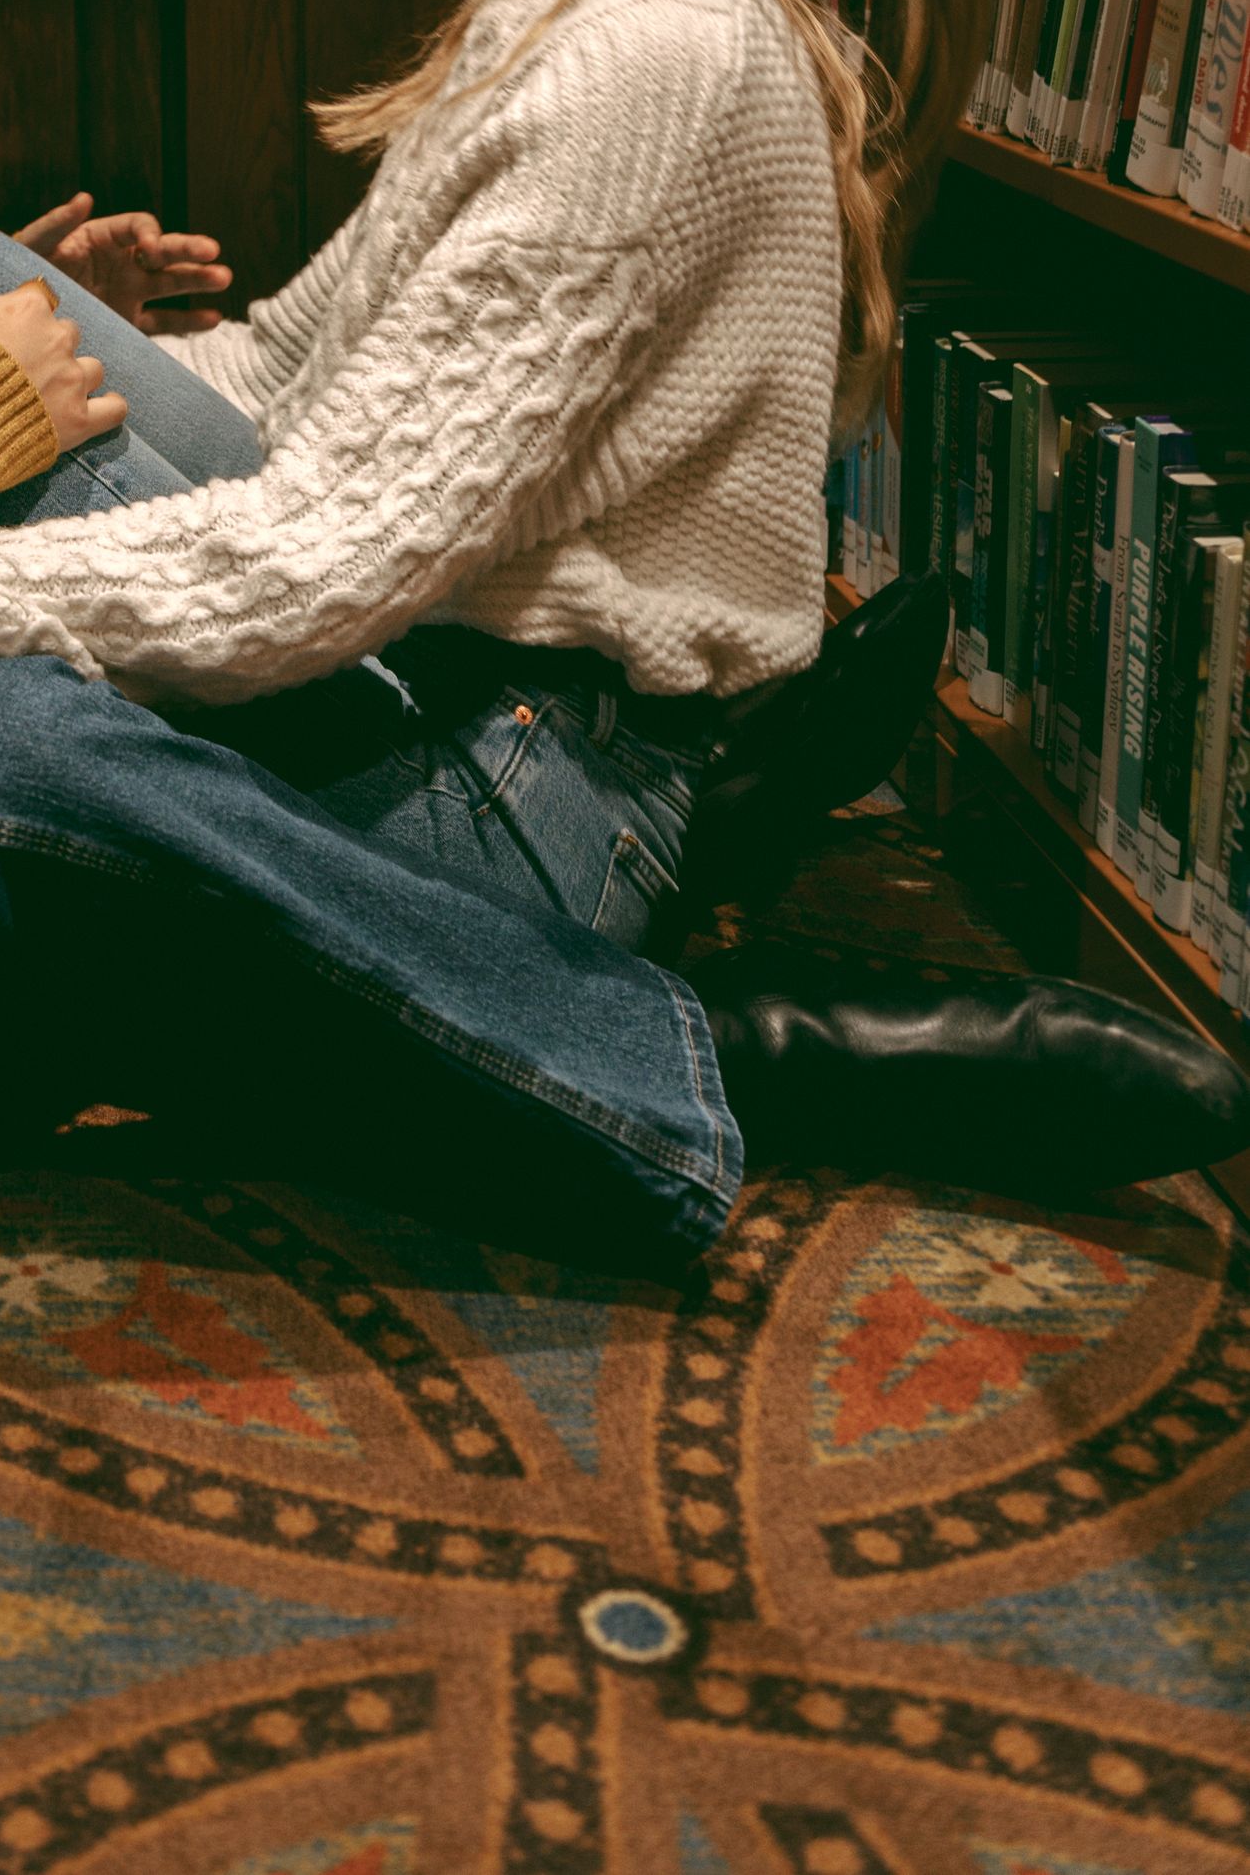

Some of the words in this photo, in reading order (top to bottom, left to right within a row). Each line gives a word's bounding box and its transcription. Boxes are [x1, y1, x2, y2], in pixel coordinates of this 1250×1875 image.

[1194, 56, 1208, 105] DAVID
[974, 454, 985, 540] WARS
[982, 467, 994, 536] STAR
[1094, 473, 1108, 542] Dad's
[1116, 534, 1130, 582] From
[1091, 572, 1103, 635] Book
[1113, 588, 1127, 638] Sarah
[1127, 538, 1151, 658] PURPLE
[1112, 644, 1123, 662] to
[1108, 666, 1123, 733] Sydney
[1123, 652, 1149, 761] RISING
